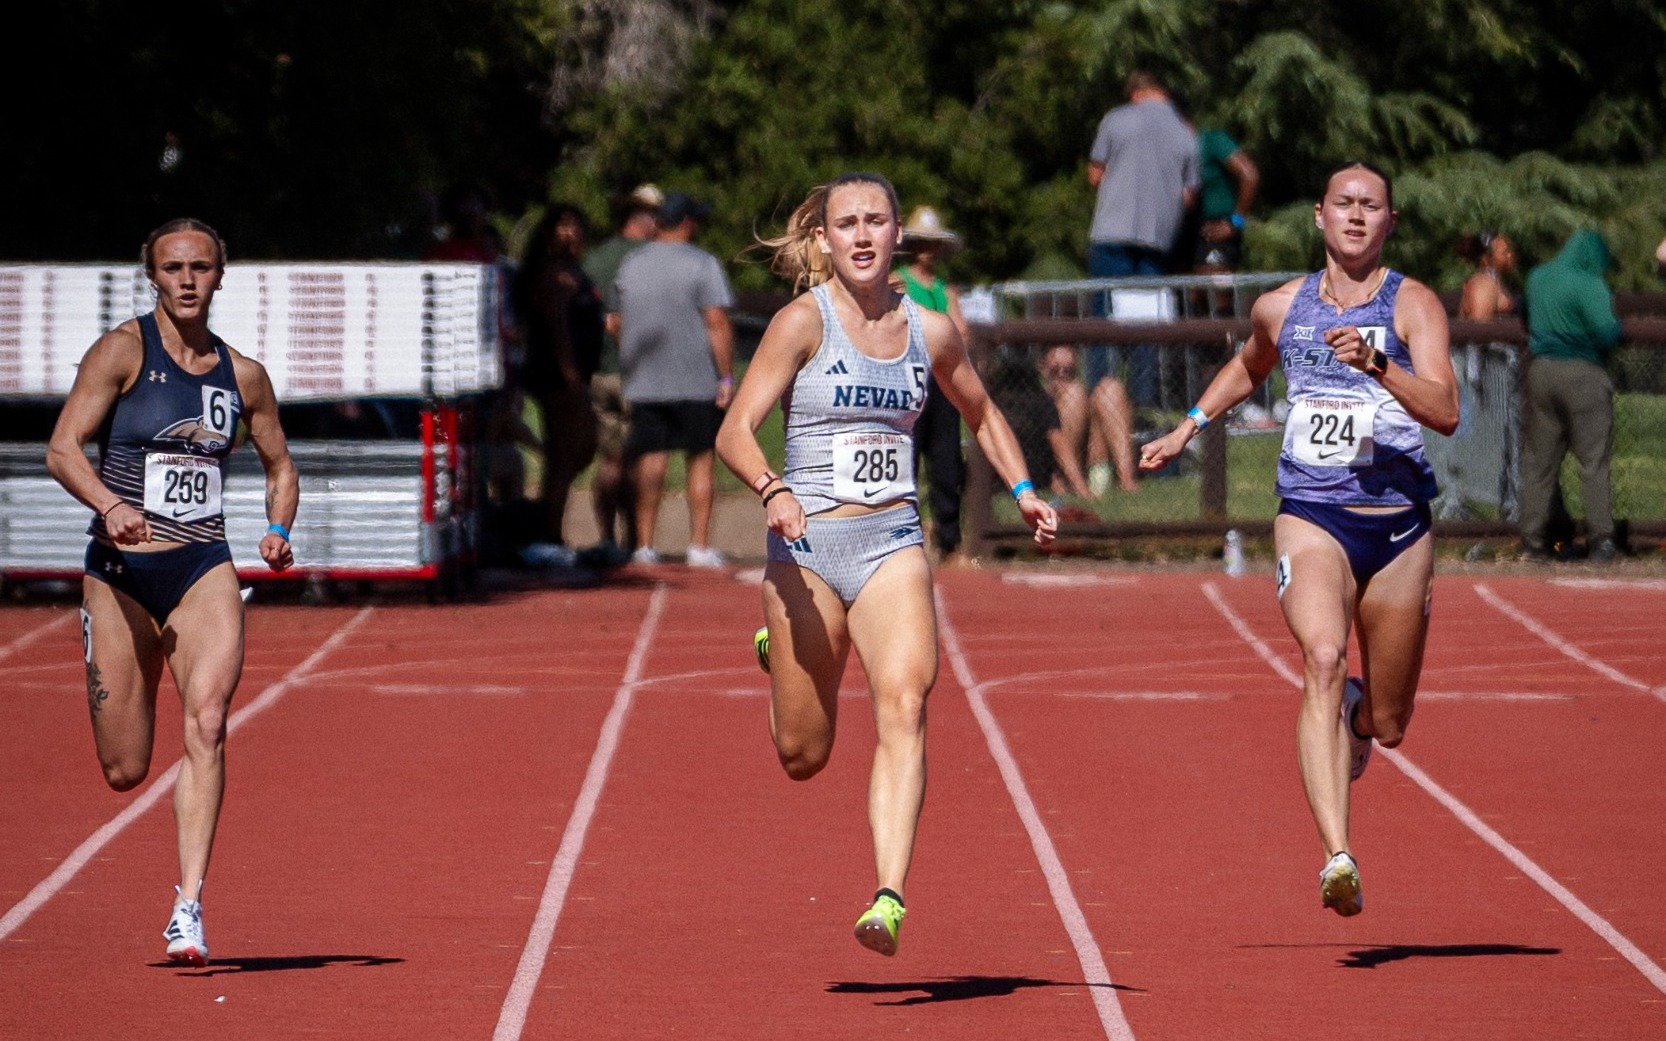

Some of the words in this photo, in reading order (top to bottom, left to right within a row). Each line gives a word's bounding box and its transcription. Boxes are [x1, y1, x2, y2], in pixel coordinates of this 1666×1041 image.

[912, 366, 925, 410] 5
[1305, 399, 1339, 410] STANFORD
[210, 390, 226, 431] 6
[844, 434, 882, 446] STANFORD
[1310, 413, 1355, 446] 224
[156, 454, 193, 467] STANFORD
[853, 449, 898, 482] 285
[164, 469, 208, 505] 259
[83, 615, 89, 658] 6
